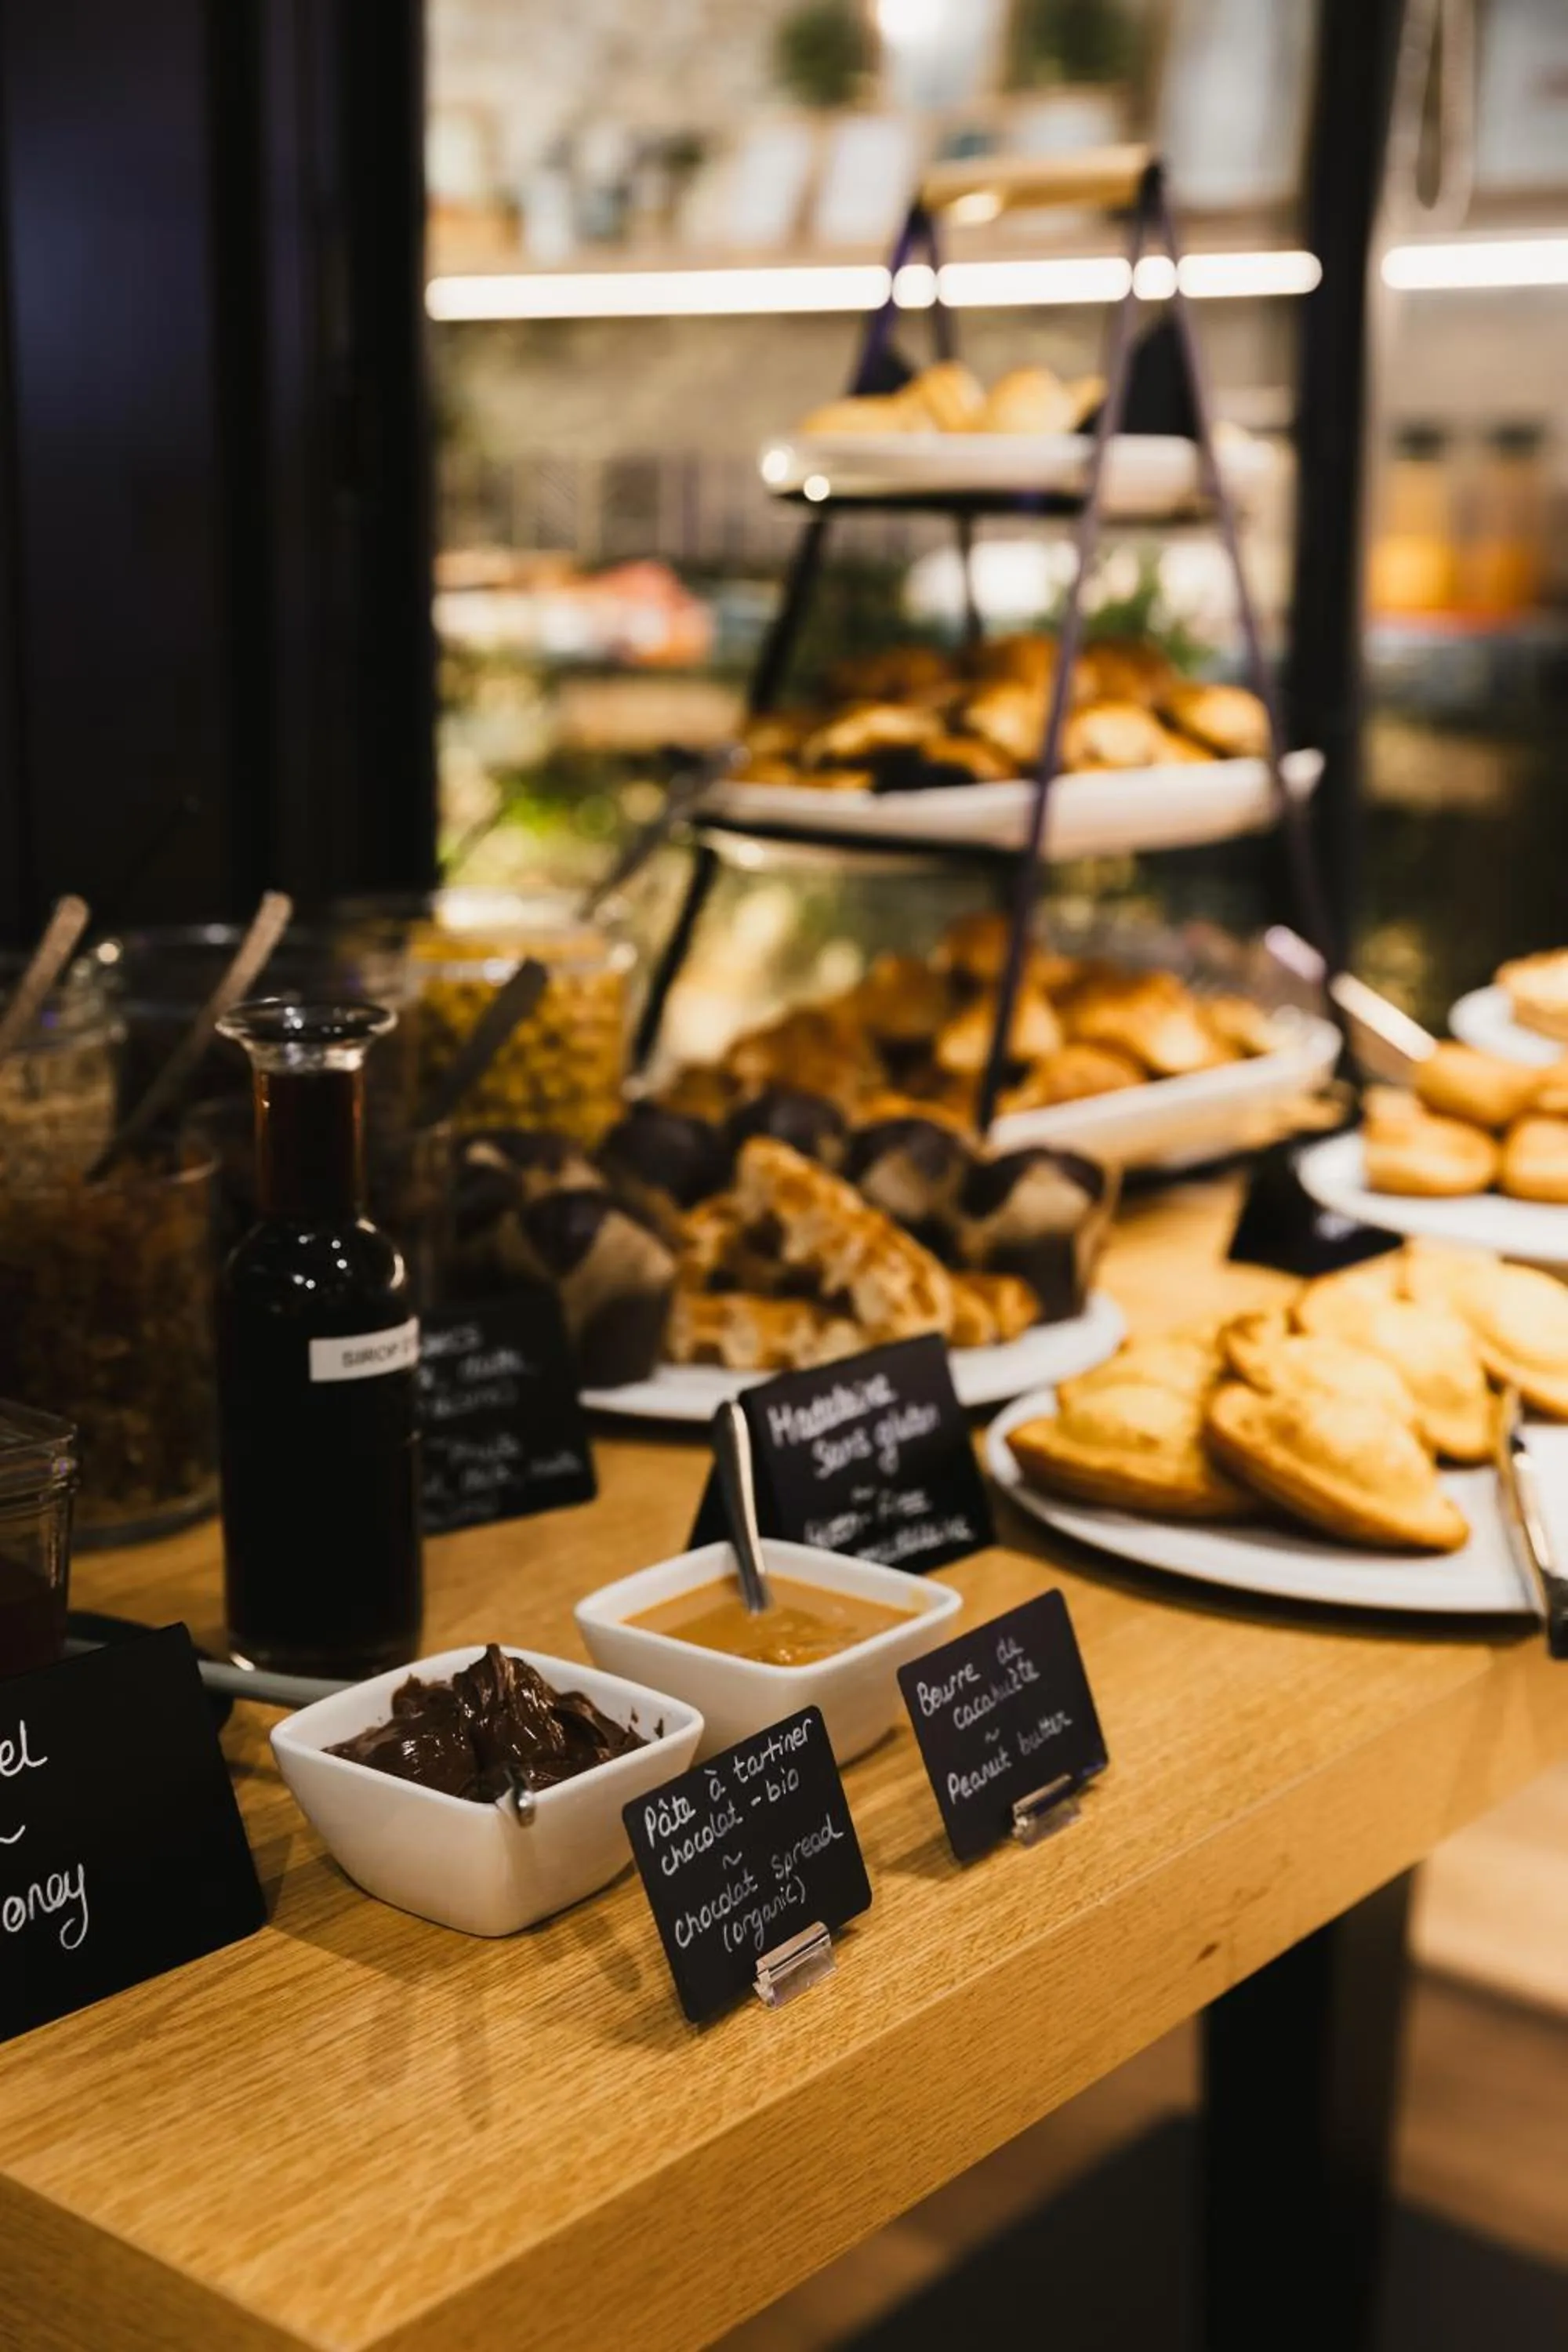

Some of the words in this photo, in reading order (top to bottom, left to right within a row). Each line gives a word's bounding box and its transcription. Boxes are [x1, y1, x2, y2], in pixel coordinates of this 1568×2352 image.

[916, 1663, 980, 1717] Beurre
[996, 1636, 1024, 1664] de
[644, 1795, 695, 1847] Pâte
[704, 1769, 725, 1801] à
[733, 1718, 812, 1783] tartiner
[947, 1746, 1013, 1804] Peanut
[1017, 1711, 1073, 1755] butter
[661, 1804, 743, 1876] chocolat
[723, 1876, 806, 1951] (organic)
